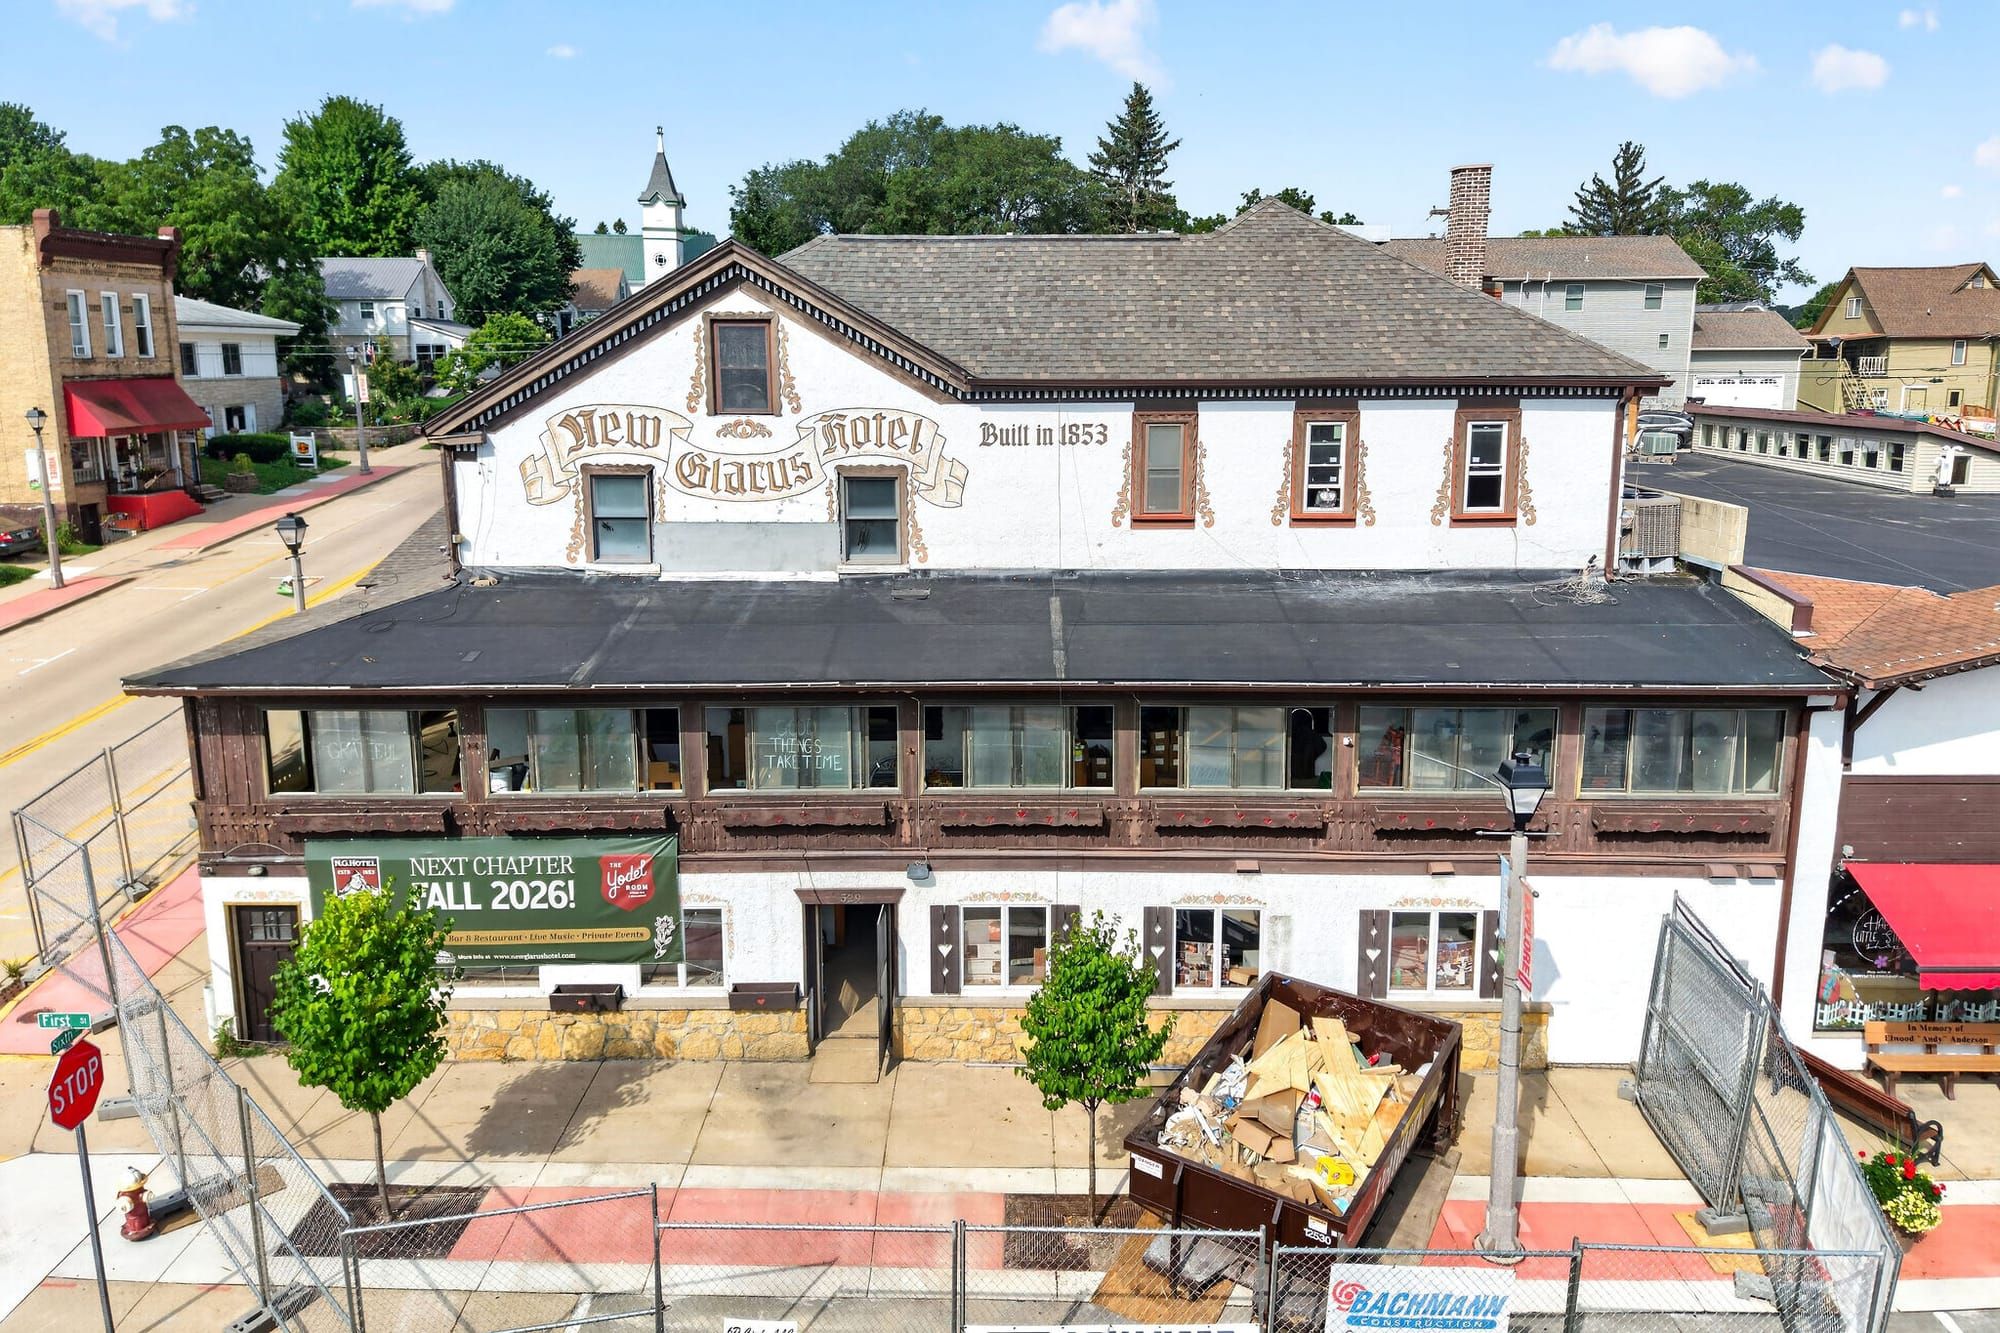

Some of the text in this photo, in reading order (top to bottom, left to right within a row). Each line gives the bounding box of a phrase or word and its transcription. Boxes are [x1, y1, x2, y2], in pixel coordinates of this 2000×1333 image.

[558, 408, 662, 456] New
[814, 412, 923, 456] Hotel
[979, 421, 1108, 447] Built in 1853
[675, 451, 813, 495] Glarus
[769, 737, 822, 754] THINGS
[763, 754, 843, 771] TAKE TIME
[409, 855, 575, 877] NEXT CHAPTER
[411, 879, 576, 911] FALL 2026!
[474, 934, 522, 943] Restaurant
[529, 933, 547, 941] Live
[549, 932, 575, 941] Music
[582, 931, 613, 940] Private
[615, 931, 644, 939] Events
[1855, 931, 1878, 943] LITTLE
[42, 1015, 71, 1027] First
[1920, 1024, 1952, 1033] Memory
[52, 1030, 74, 1052] Sixth
[1885, 1034, 1914, 1042] Elwood
[54, 1057, 98, 1113] STOP
[1349, 1290, 1511, 1318] BACHMANN
[1359, 1317, 1484, 1328] CONSTRUCTION
